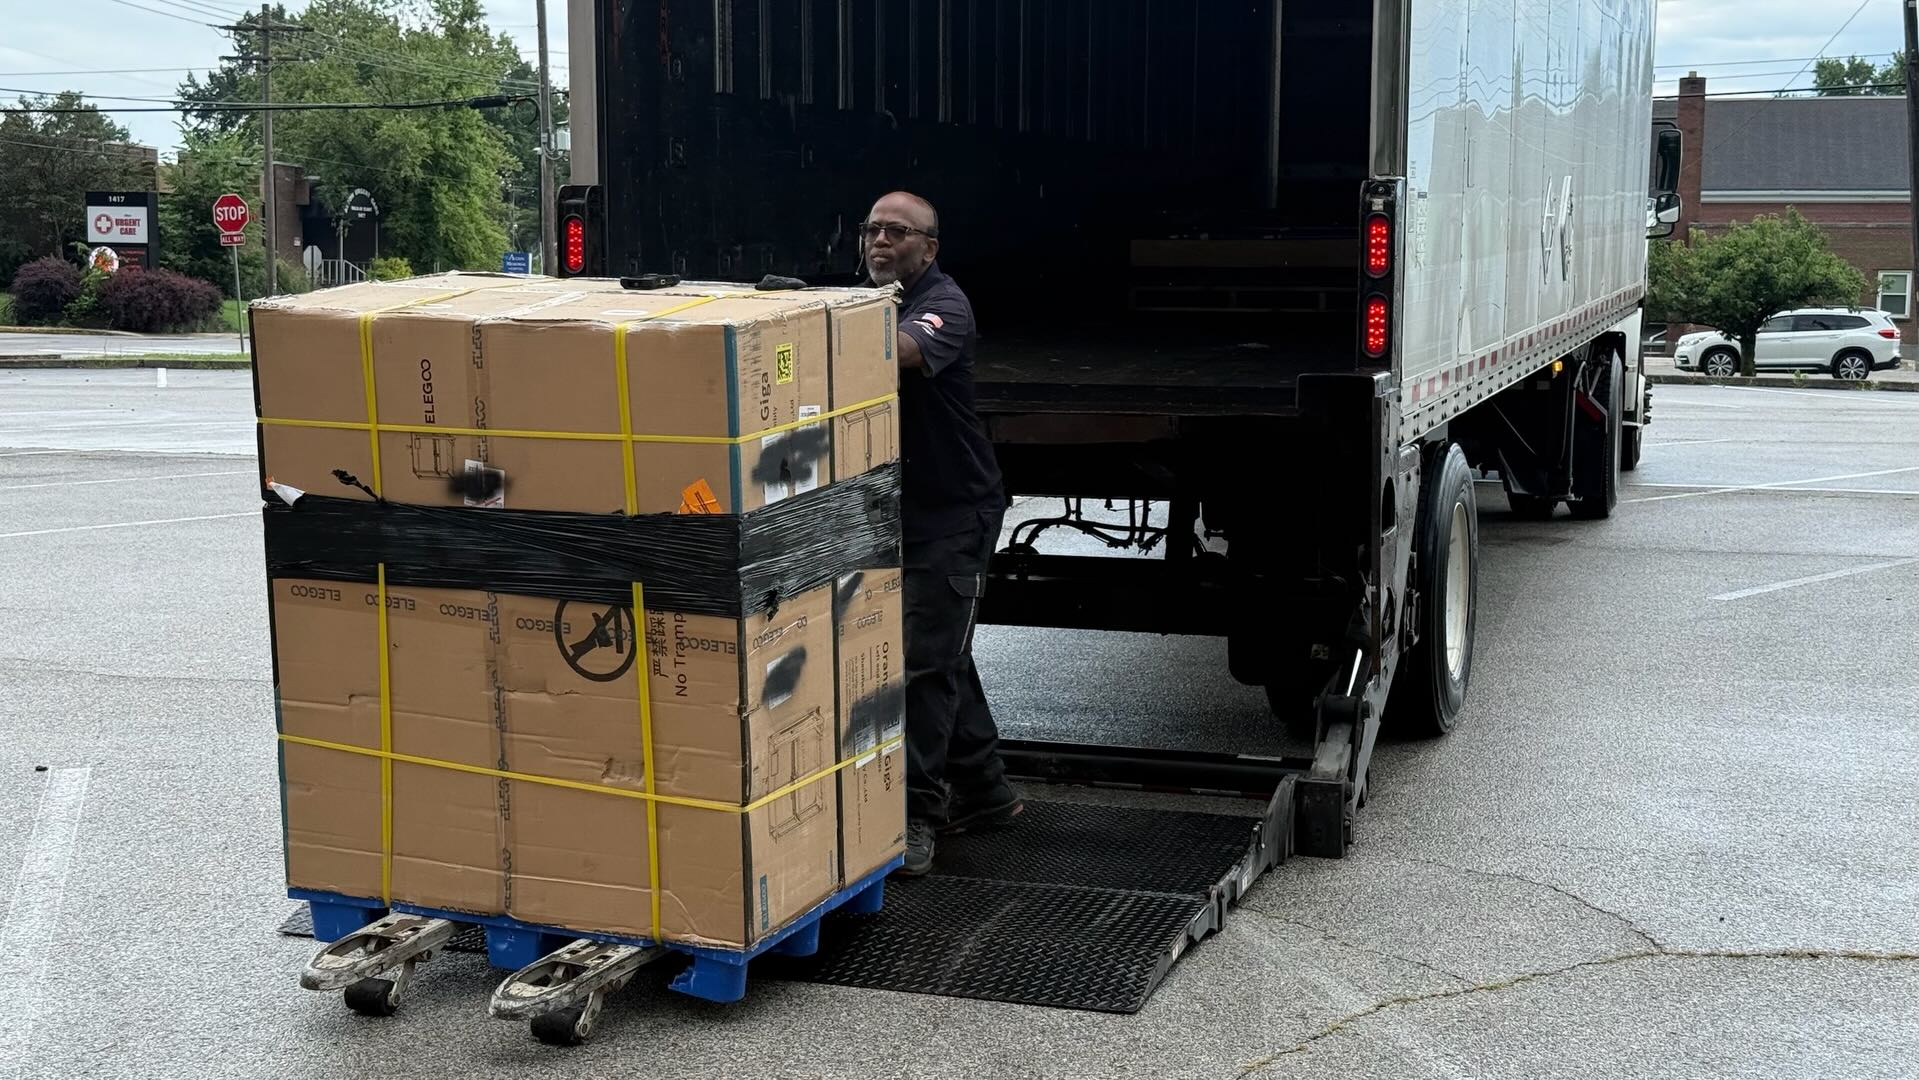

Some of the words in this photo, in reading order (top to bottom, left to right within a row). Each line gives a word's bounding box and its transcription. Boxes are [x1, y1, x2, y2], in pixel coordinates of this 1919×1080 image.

[115, 218, 141, 227] URGENT
[216, 206, 246, 222] STOP
[119, 227, 137, 236] CARE
[420, 358, 436, 425] ELEGOO
[760, 371, 772, 421] Giga
[290, 584, 342, 602] ELEGOO
[440, 603, 490, 622] ELEGOO
[516, 617, 572, 635] EEGOO
[675, 673, 688, 697] No
[883, 755, 893, 792] Giga
